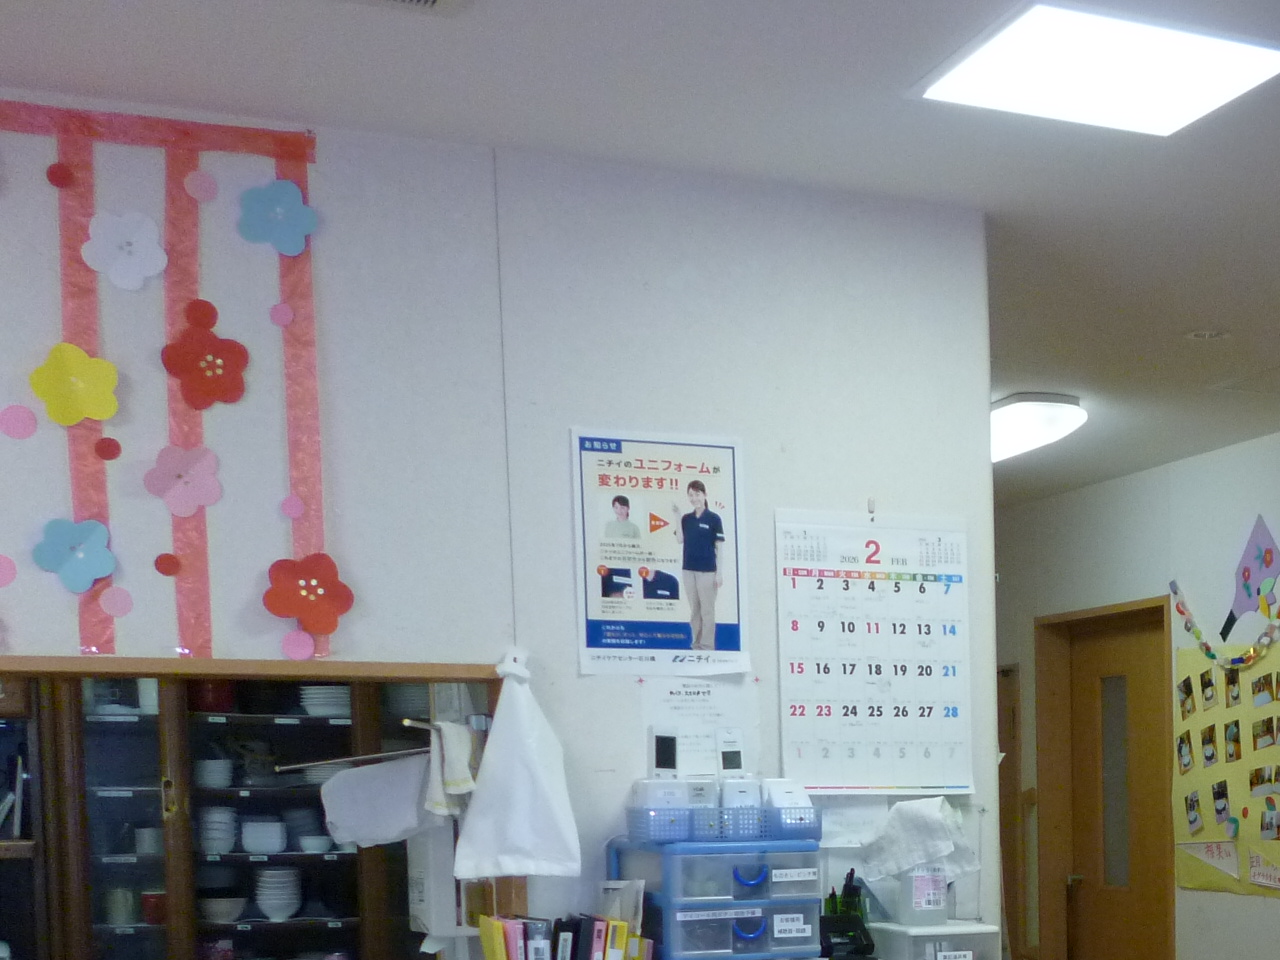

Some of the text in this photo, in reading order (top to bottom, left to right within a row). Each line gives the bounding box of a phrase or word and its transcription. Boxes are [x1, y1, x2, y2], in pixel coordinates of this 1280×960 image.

[584, 440, 617, 449] お知らせ
[597, 458, 721, 474] ニチイのユニフォームが
[865, 540, 880, 564] 2
[791, 578, 951, 594] 1 2 3 4 5 6 7
[791, 620, 956, 636] 8 9 10 11 12 13 14
[687, 655, 711, 663] ニチイ
[790, 663, 956, 676] 15 16 17 18 19 20 21
[790, 705, 958, 718] 22 23 24 25 26 27 28
